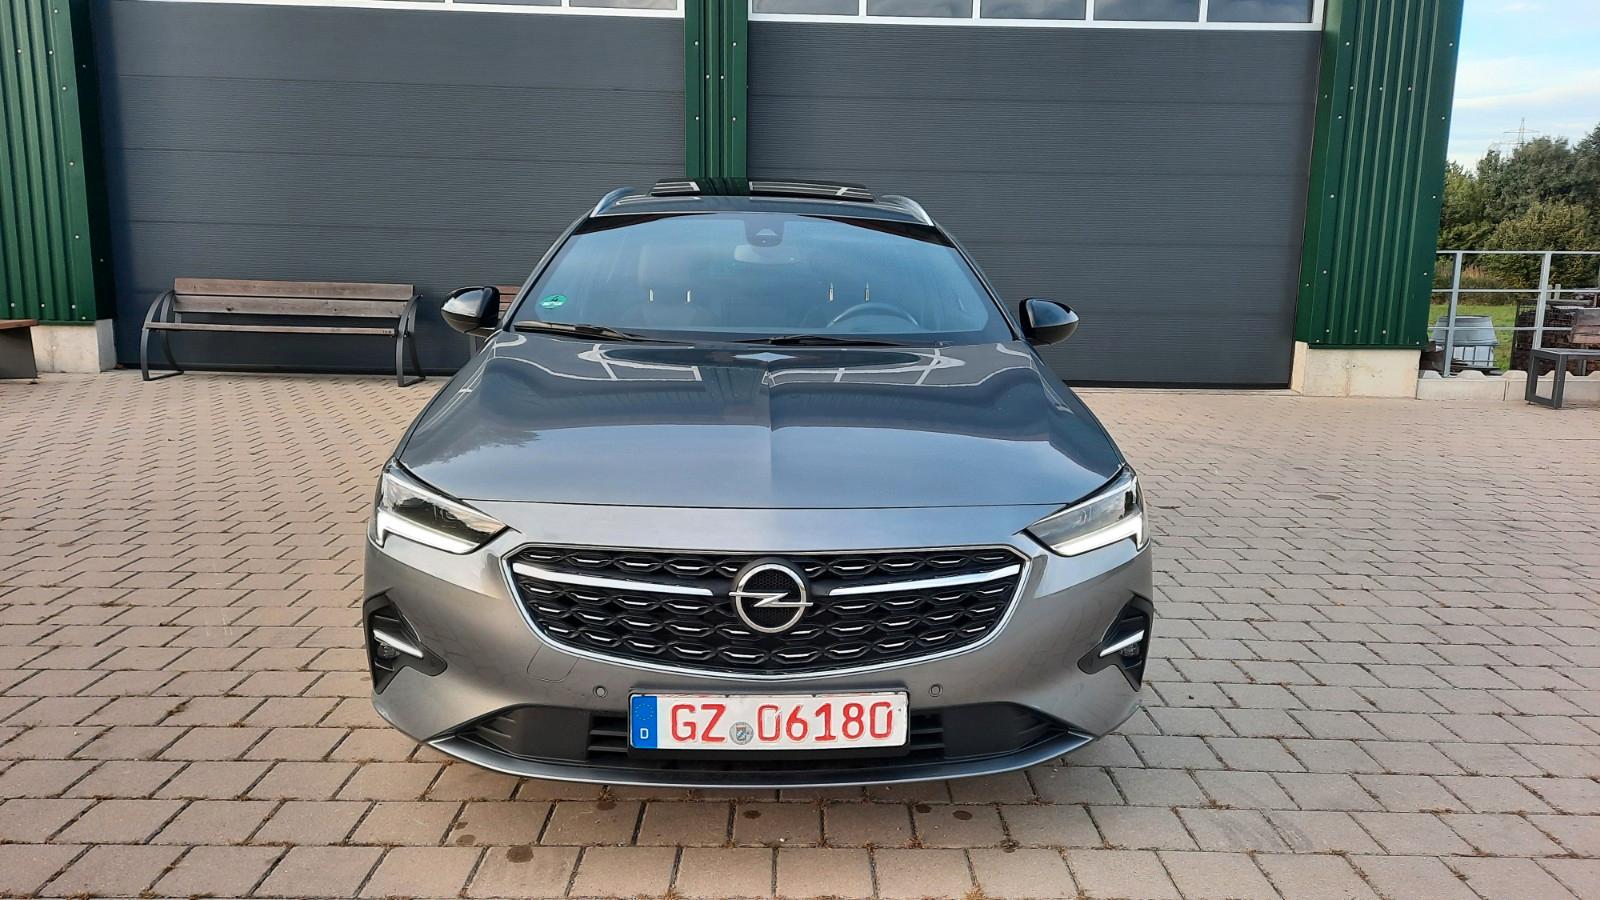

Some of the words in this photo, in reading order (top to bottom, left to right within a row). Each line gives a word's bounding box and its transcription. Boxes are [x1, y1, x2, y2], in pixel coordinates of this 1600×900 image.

[640, 727, 649, 740] D
[670, 703, 727, 743] GZ
[757, 701, 894, 743] 06180
